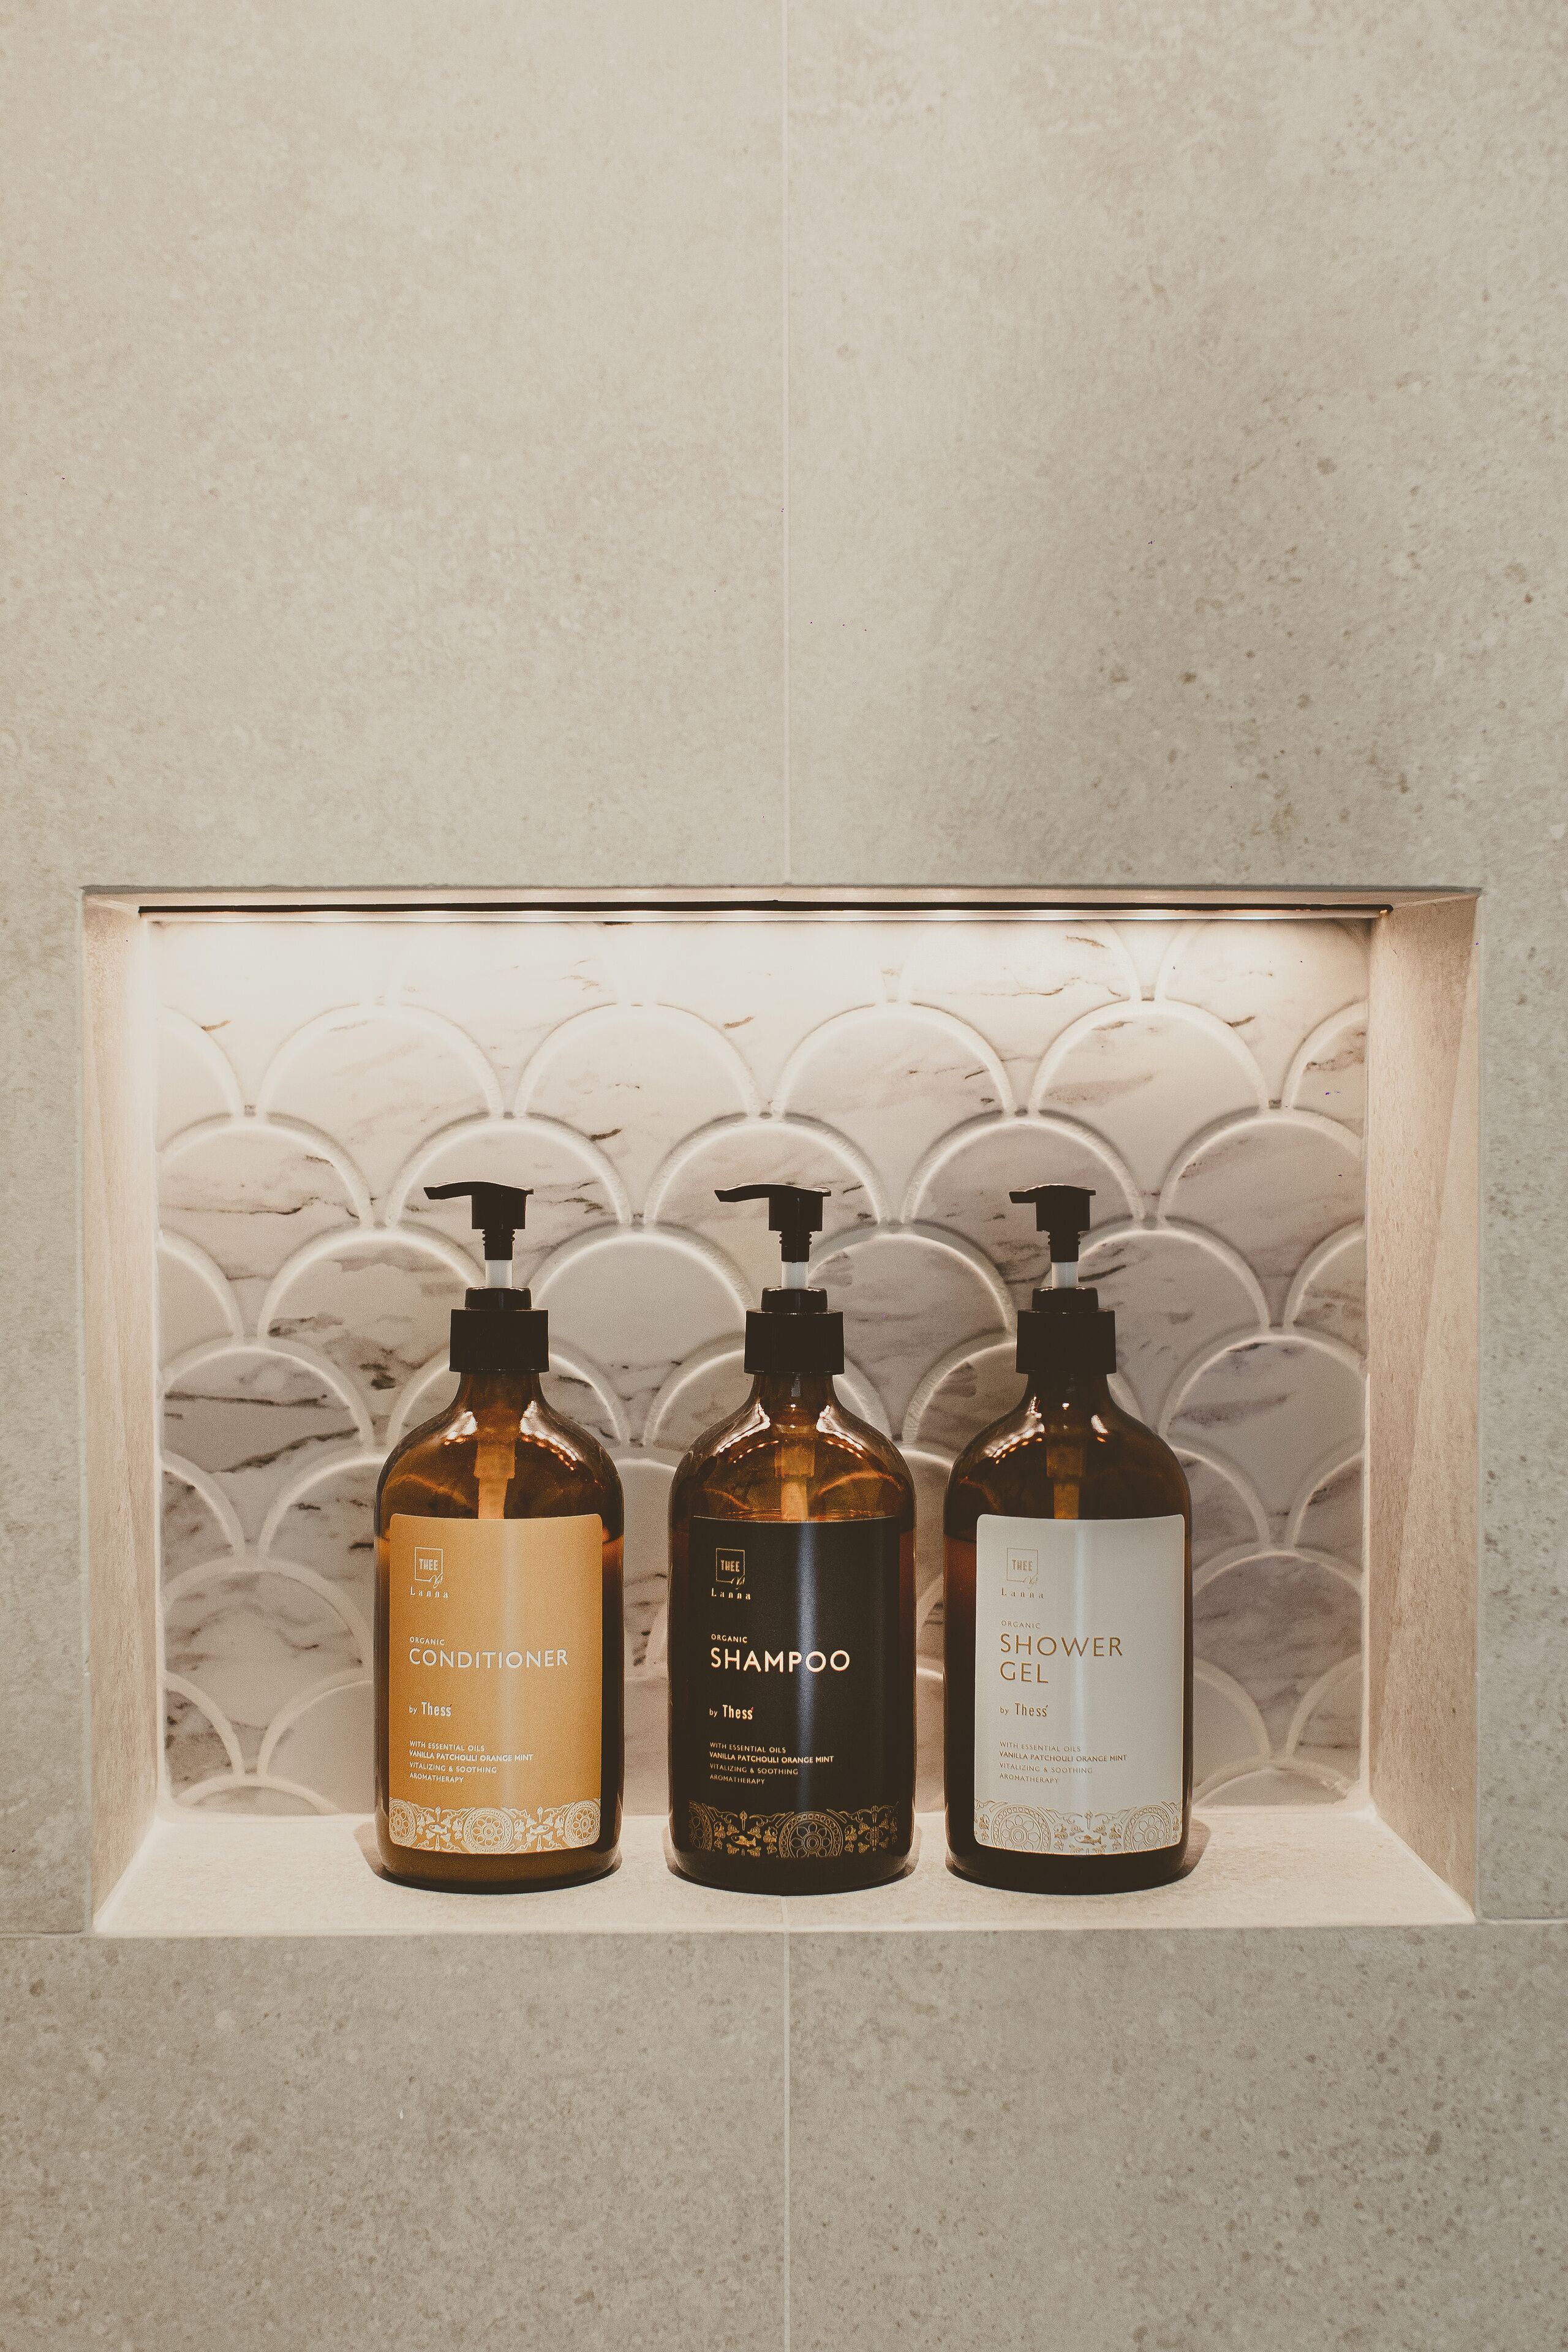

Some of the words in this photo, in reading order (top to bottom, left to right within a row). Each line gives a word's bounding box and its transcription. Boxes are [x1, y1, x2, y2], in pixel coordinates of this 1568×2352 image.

[419, 1558, 438, 1571] THEE
[720, 1559, 740, 1572] THEE
[1012, 1559, 1033, 1572] THEE
[410, 1586, 449, 1599] Lanna
[711, 1588, 751, 1600] Lanna
[1001, 1587, 1044, 1599] Lanna
[1001, 1620, 1041, 1629] ORGANIC
[409, 1636, 445, 1645] ORGANIC
[710, 1634, 748, 1644] ORGANIC
[1000, 1633, 1123, 1657] SHOWER
[409, 1648, 568, 1668] CONDITIONER
[710, 1647, 850, 1673] SHAMPOO
[1000, 1661, 1049, 1683] GEL
[409, 1705, 418, 1714] by
[709, 1708, 718, 1717] by
[1000, 1706, 1009, 1715] by
[409, 1740, 426, 1748] WITH
[428, 1743, 465, 1751] ESSENTIAL
[729, 1744, 766, 1753] ESSENTIAL
[1021, 1743, 1060, 1751] ESSENTIAL
[409, 1750, 435, 1759] VANILLA
[436, 1753, 477, 1762] PATCHOULI
[709, 1751, 736, 1761] VANILLA
[737, 1754, 779, 1764] PATCHOULI
[999, 1751, 1028, 1760] VANILLA
[1030, 1754, 1073, 1762] PATCHOULI
[409, 1761, 446, 1772] VITALIZING
[709, 1763, 747, 1773] VITALIZING
[999, 1762, 1040, 1772] VITALIZING
[409, 1772, 464, 1784] AROMATHERAPY
[709, 1774, 765, 1785] AROMATHERAPY
[999, 1773, 1059, 1784] AROMATHERAPY
